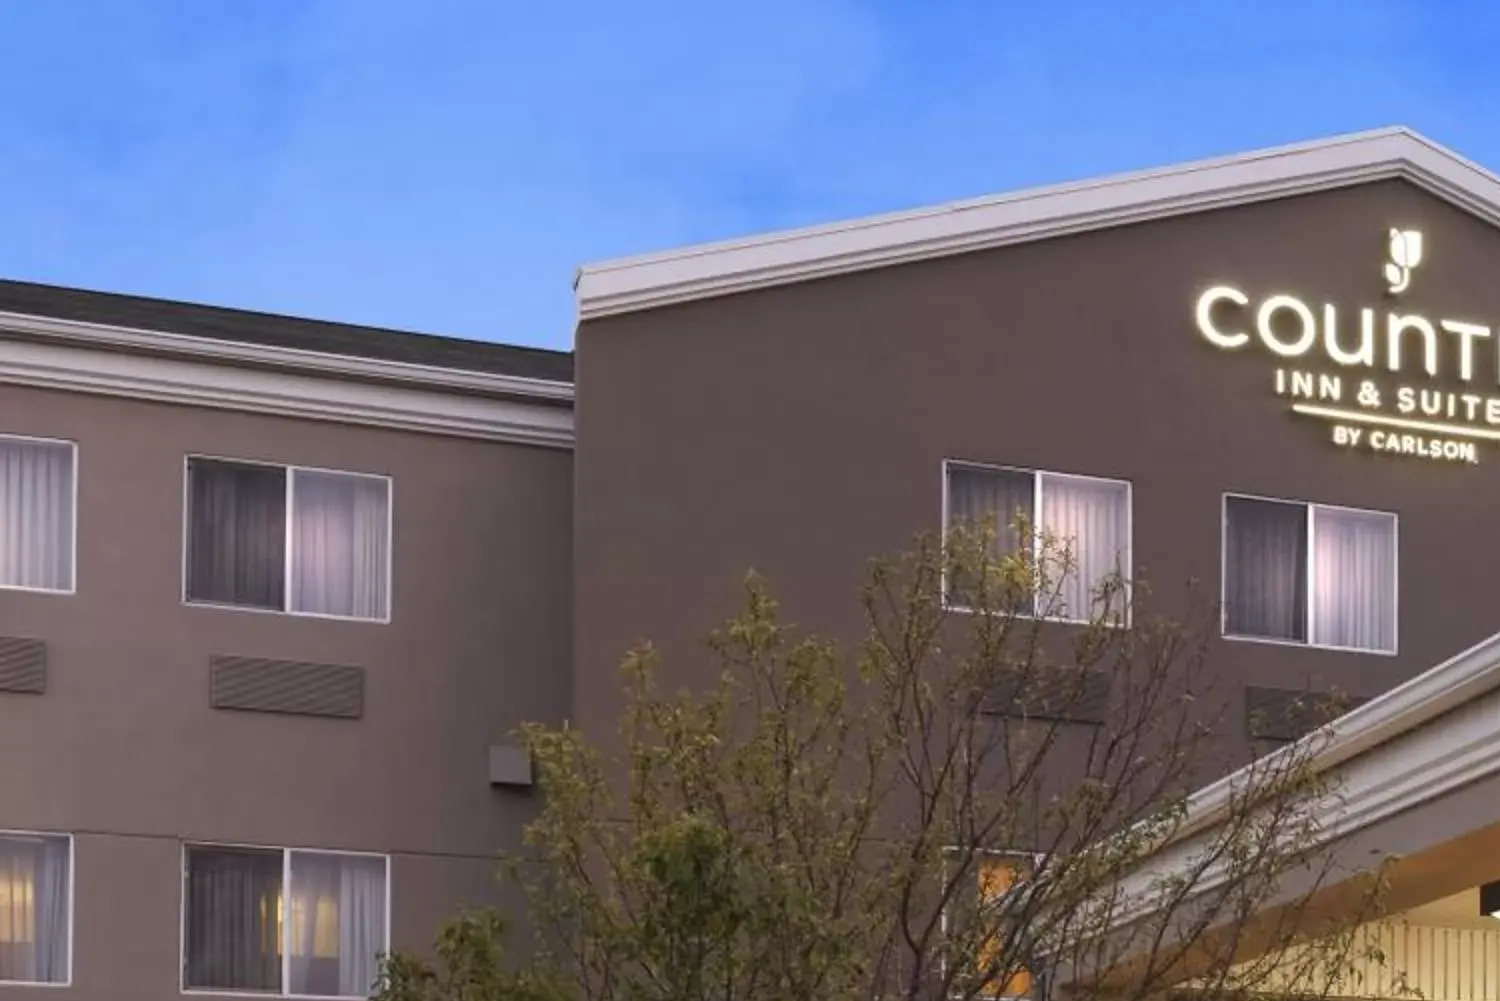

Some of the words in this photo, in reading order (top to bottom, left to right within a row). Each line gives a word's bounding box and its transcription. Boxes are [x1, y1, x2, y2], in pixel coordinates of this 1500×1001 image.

[1275, 368, 1342, 400] INN
[1357, 381, 1381, 408] &
[1333, 425, 1361, 447] BY
[1371, 431, 1477, 463] CARLSON
